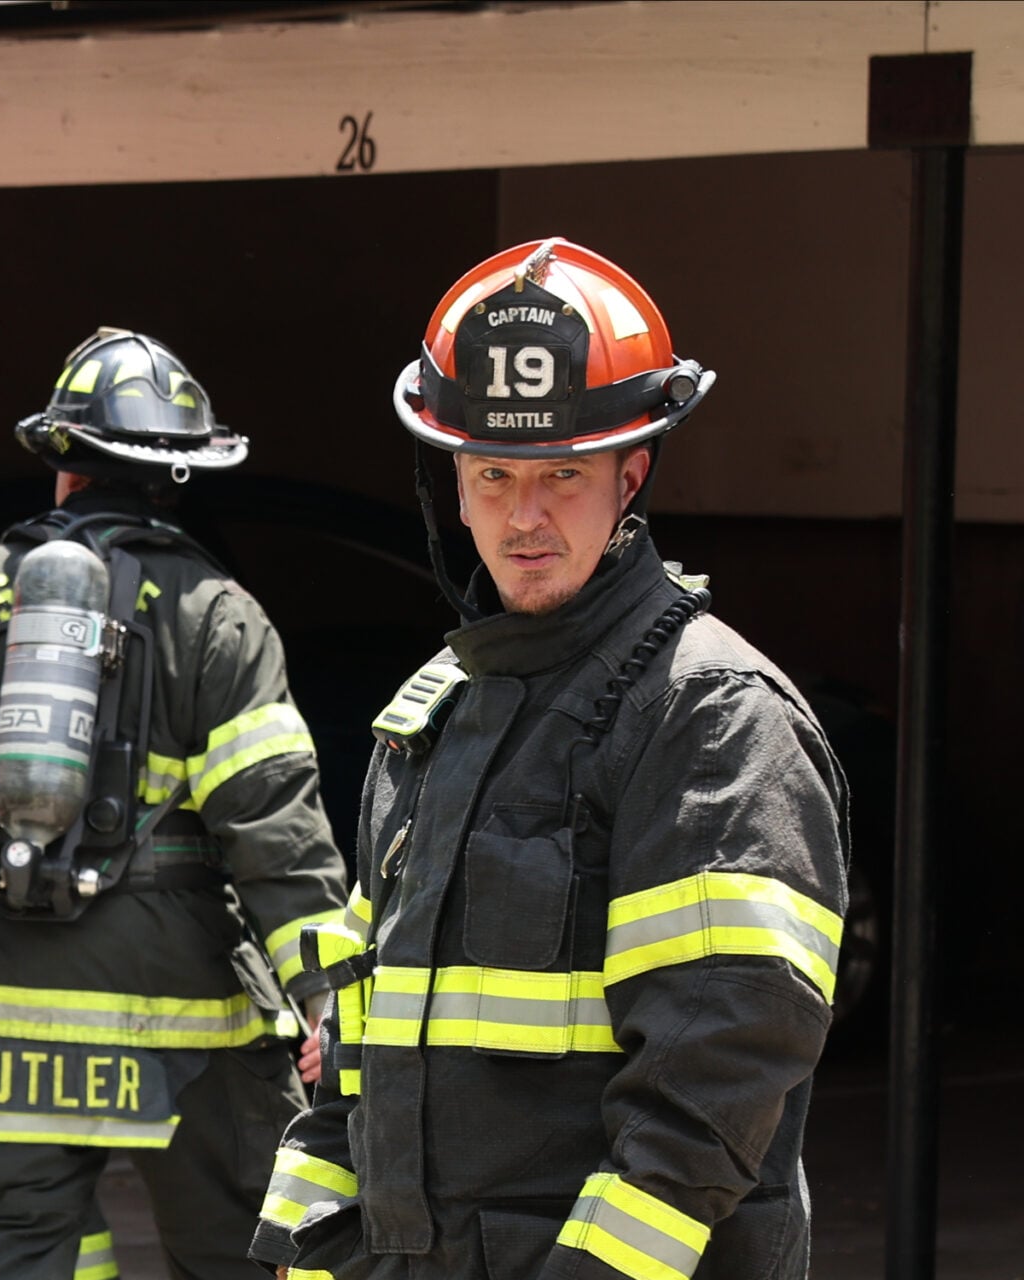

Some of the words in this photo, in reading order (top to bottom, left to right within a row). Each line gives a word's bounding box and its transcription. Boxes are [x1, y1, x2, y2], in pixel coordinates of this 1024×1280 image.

[336, 110, 377, 171] 26
[488, 307, 555, 327] CAPTAIN
[486, 346, 555, 398] 19
[487, 412, 553, 428] SEATTLE
